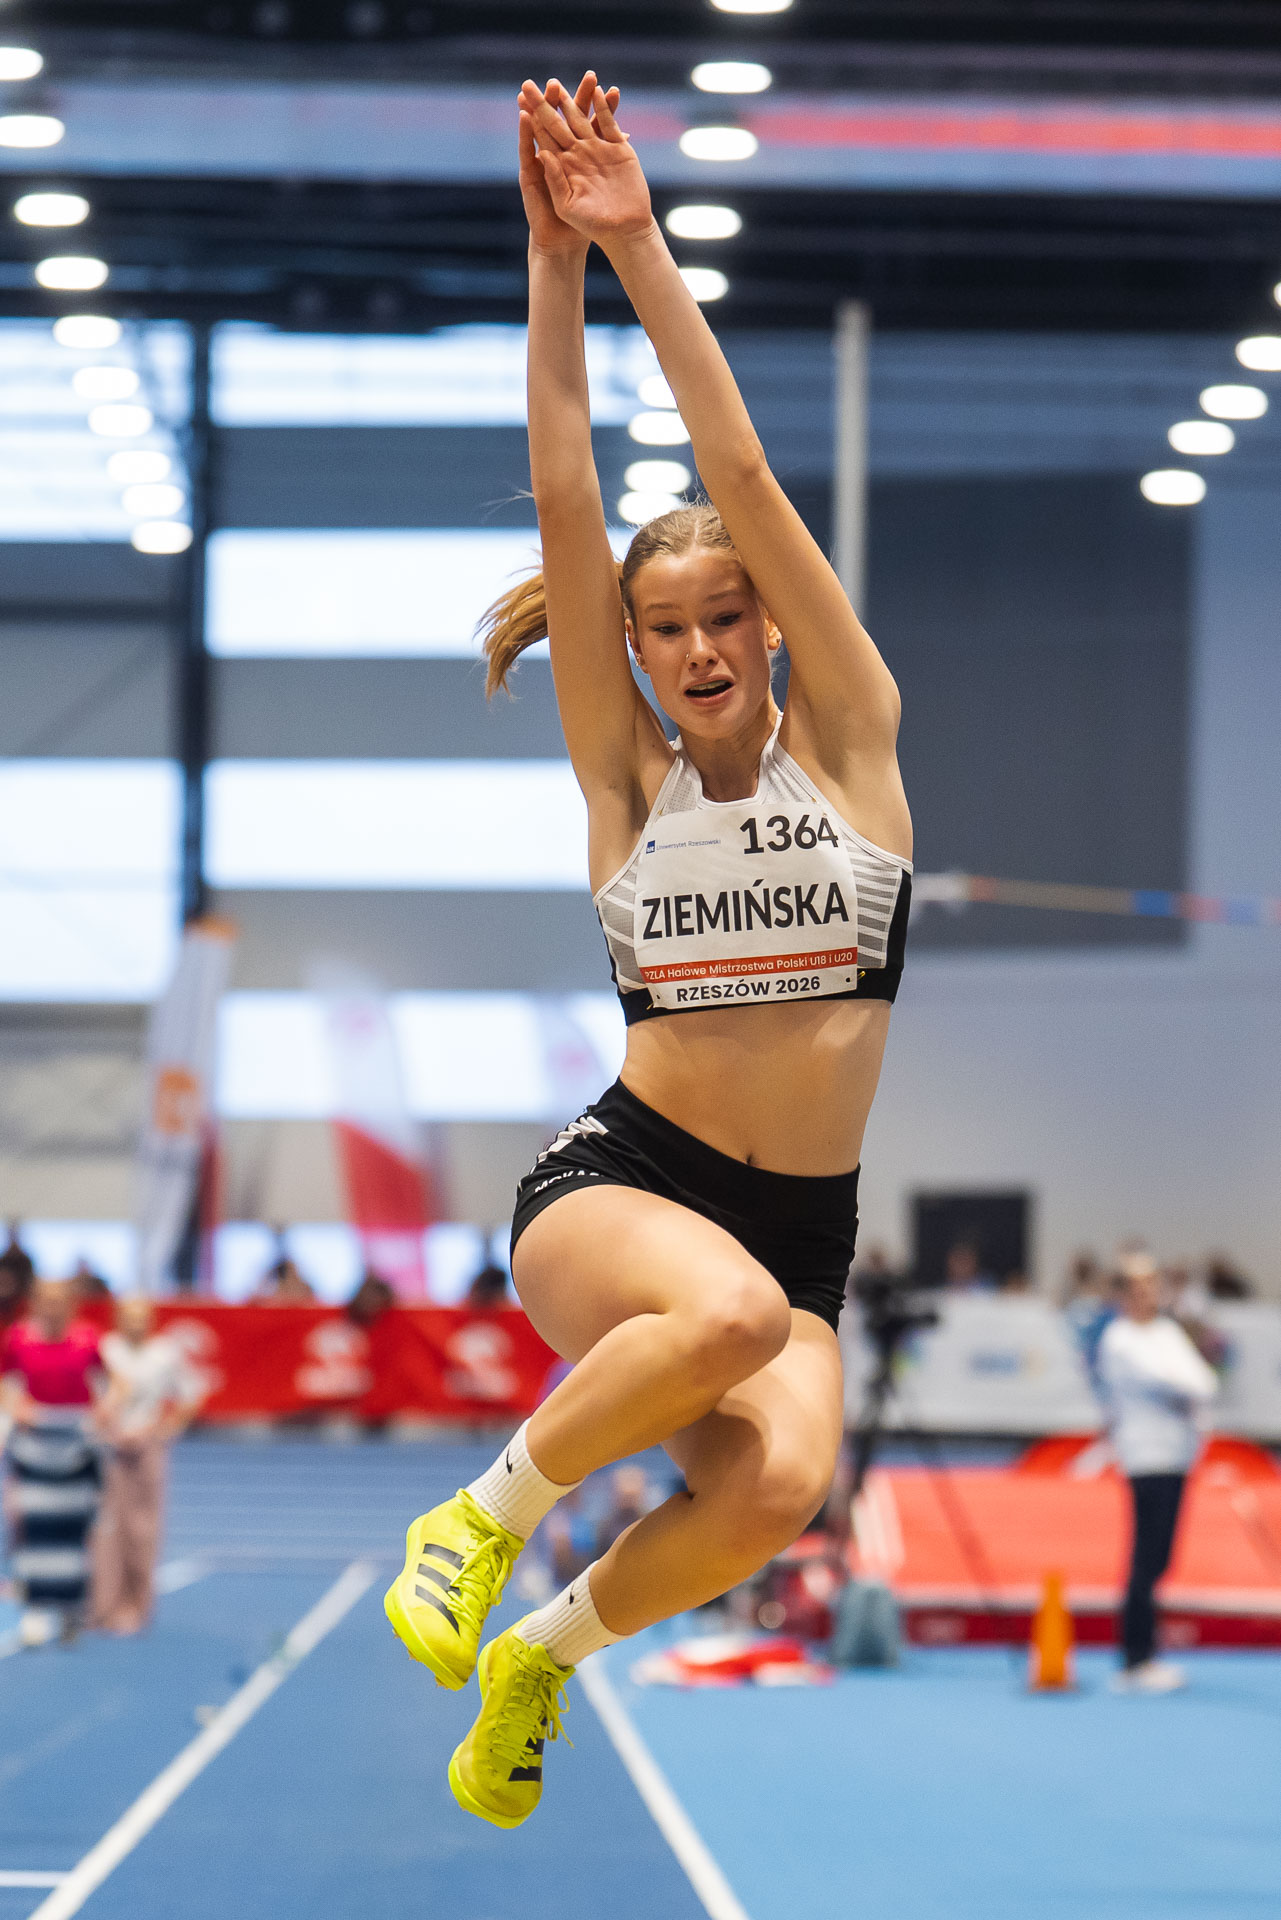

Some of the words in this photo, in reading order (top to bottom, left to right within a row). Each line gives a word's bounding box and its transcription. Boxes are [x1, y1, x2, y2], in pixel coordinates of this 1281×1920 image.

[656, 841, 687, 851] Uniwersytet
[688, 838, 721, 846] Rzeszowski
[740, 814, 839, 855] 1364
[642, 878, 850, 941] ZIEMIŃSKA
[667, 967, 707, 978] Halowe
[709, 961, 774, 975] Mistrzostwa
[776, 956, 808, 969] Polski
[810, 955, 827, 966] U18
[828, 954, 832, 964] i
[834, 952, 853, 963] U20
[676, 978, 771, 1002] RZESZÓW
[775, 975, 821, 994] 2026
